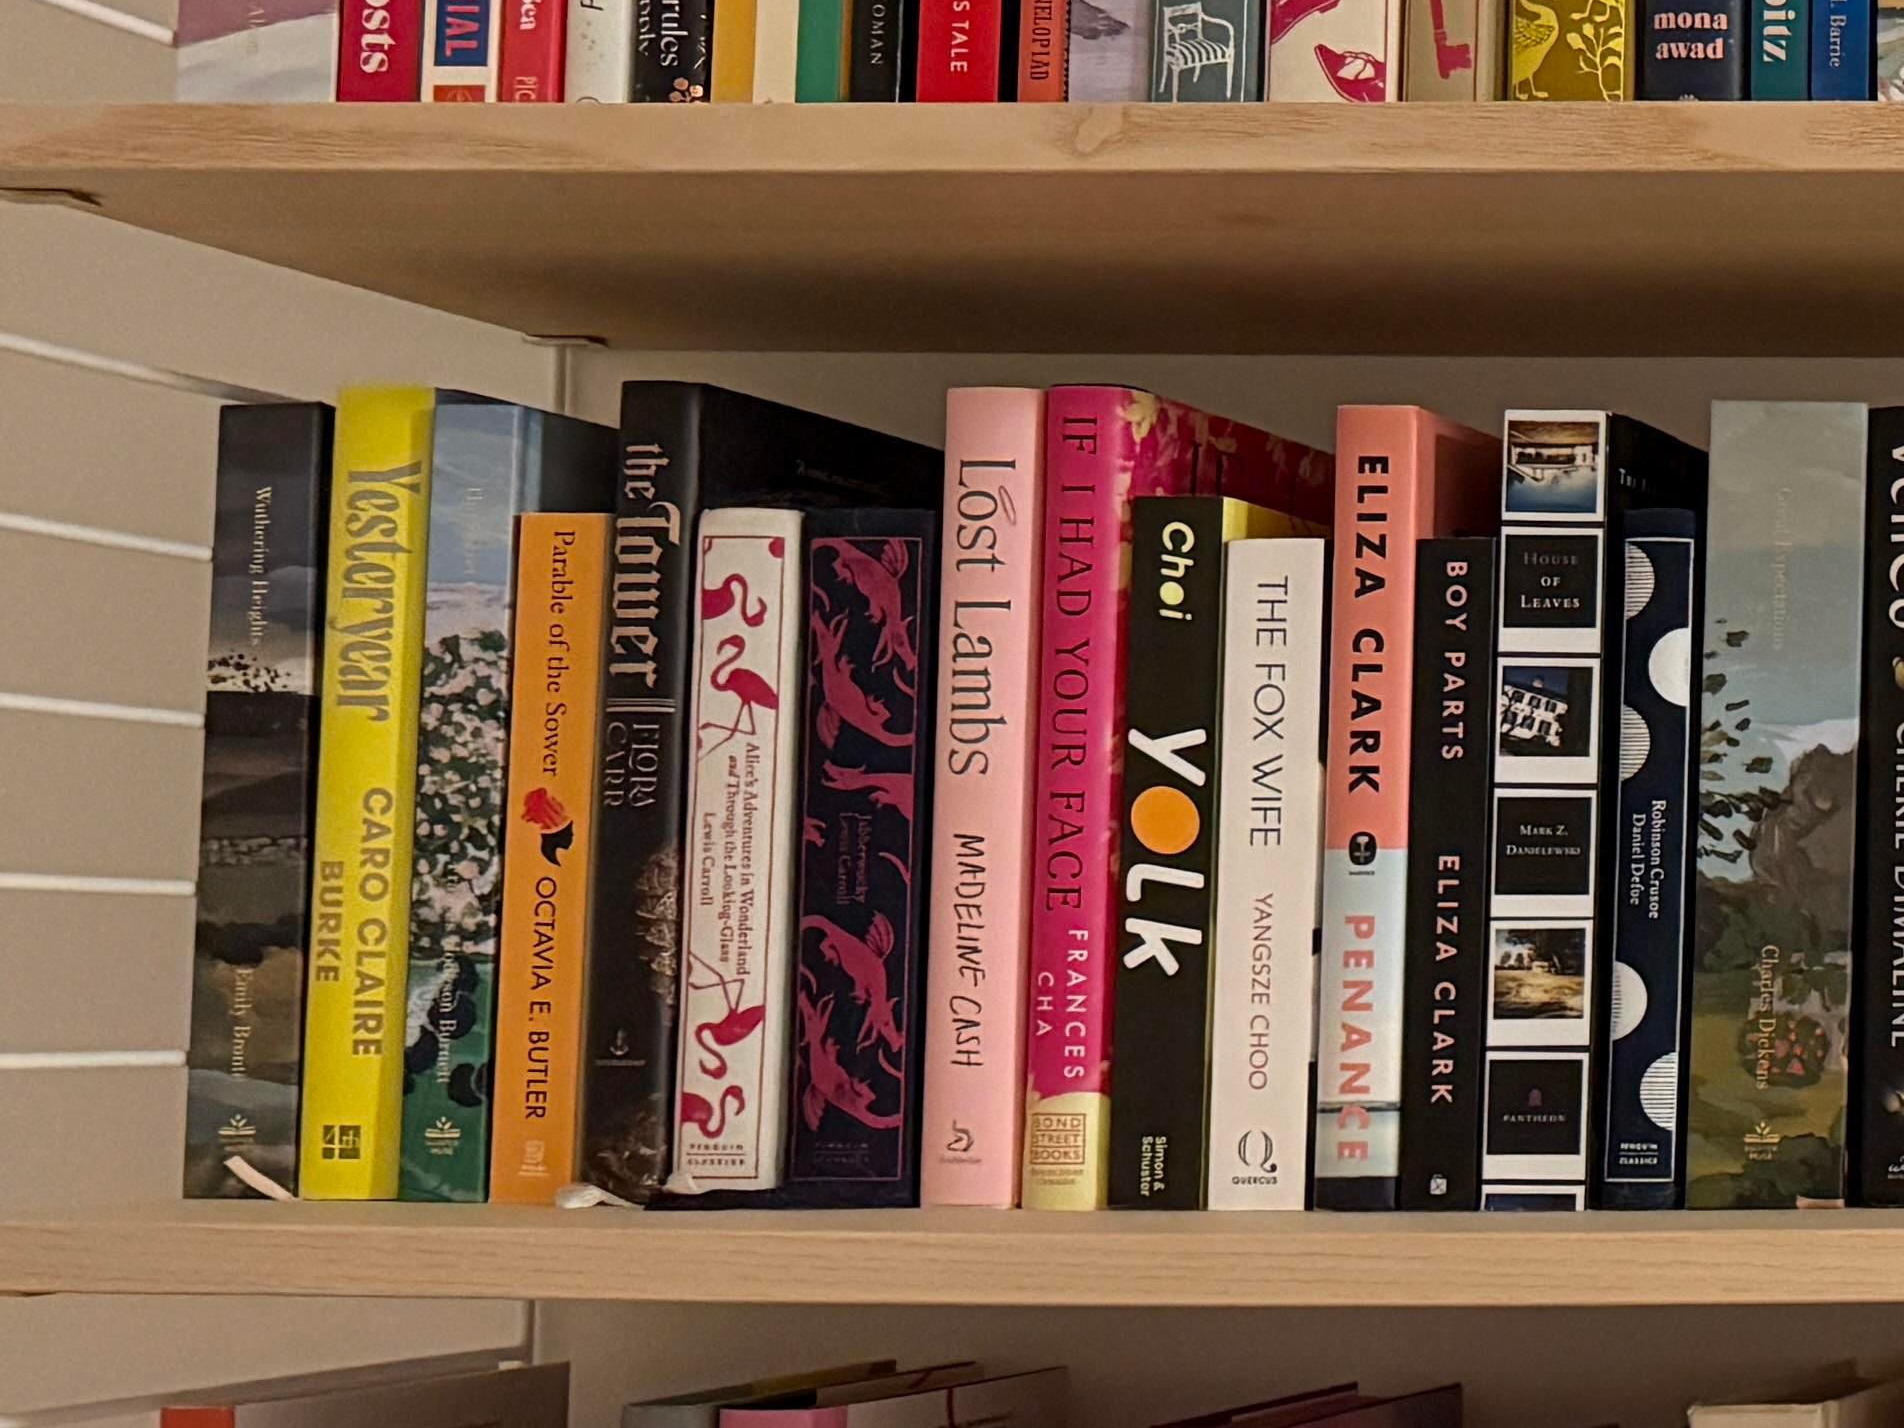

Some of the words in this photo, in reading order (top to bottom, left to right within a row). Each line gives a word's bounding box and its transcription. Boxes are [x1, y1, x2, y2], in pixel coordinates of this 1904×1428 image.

[949, 19, 971, 76] TALE
[1654, 8, 1728, 32] mona
[1655, 38, 1724, 60] awad
[1354, 452, 1392, 600] ELIZA
[1252, 575, 1290, 650] THE
[949, 597, 1015, 778] Lambs
[1249, 666, 1289, 745] FOX
[1345, 627, 1387, 795] CLARK
[1247, 757, 1286, 849] WIFE
[531, 874, 559, 991] OCTAVIA
[528, 992, 554, 1026] E.
[1333, 913, 1378, 1163] PENANCE
[524, 1028, 553, 1122] BUTLER
